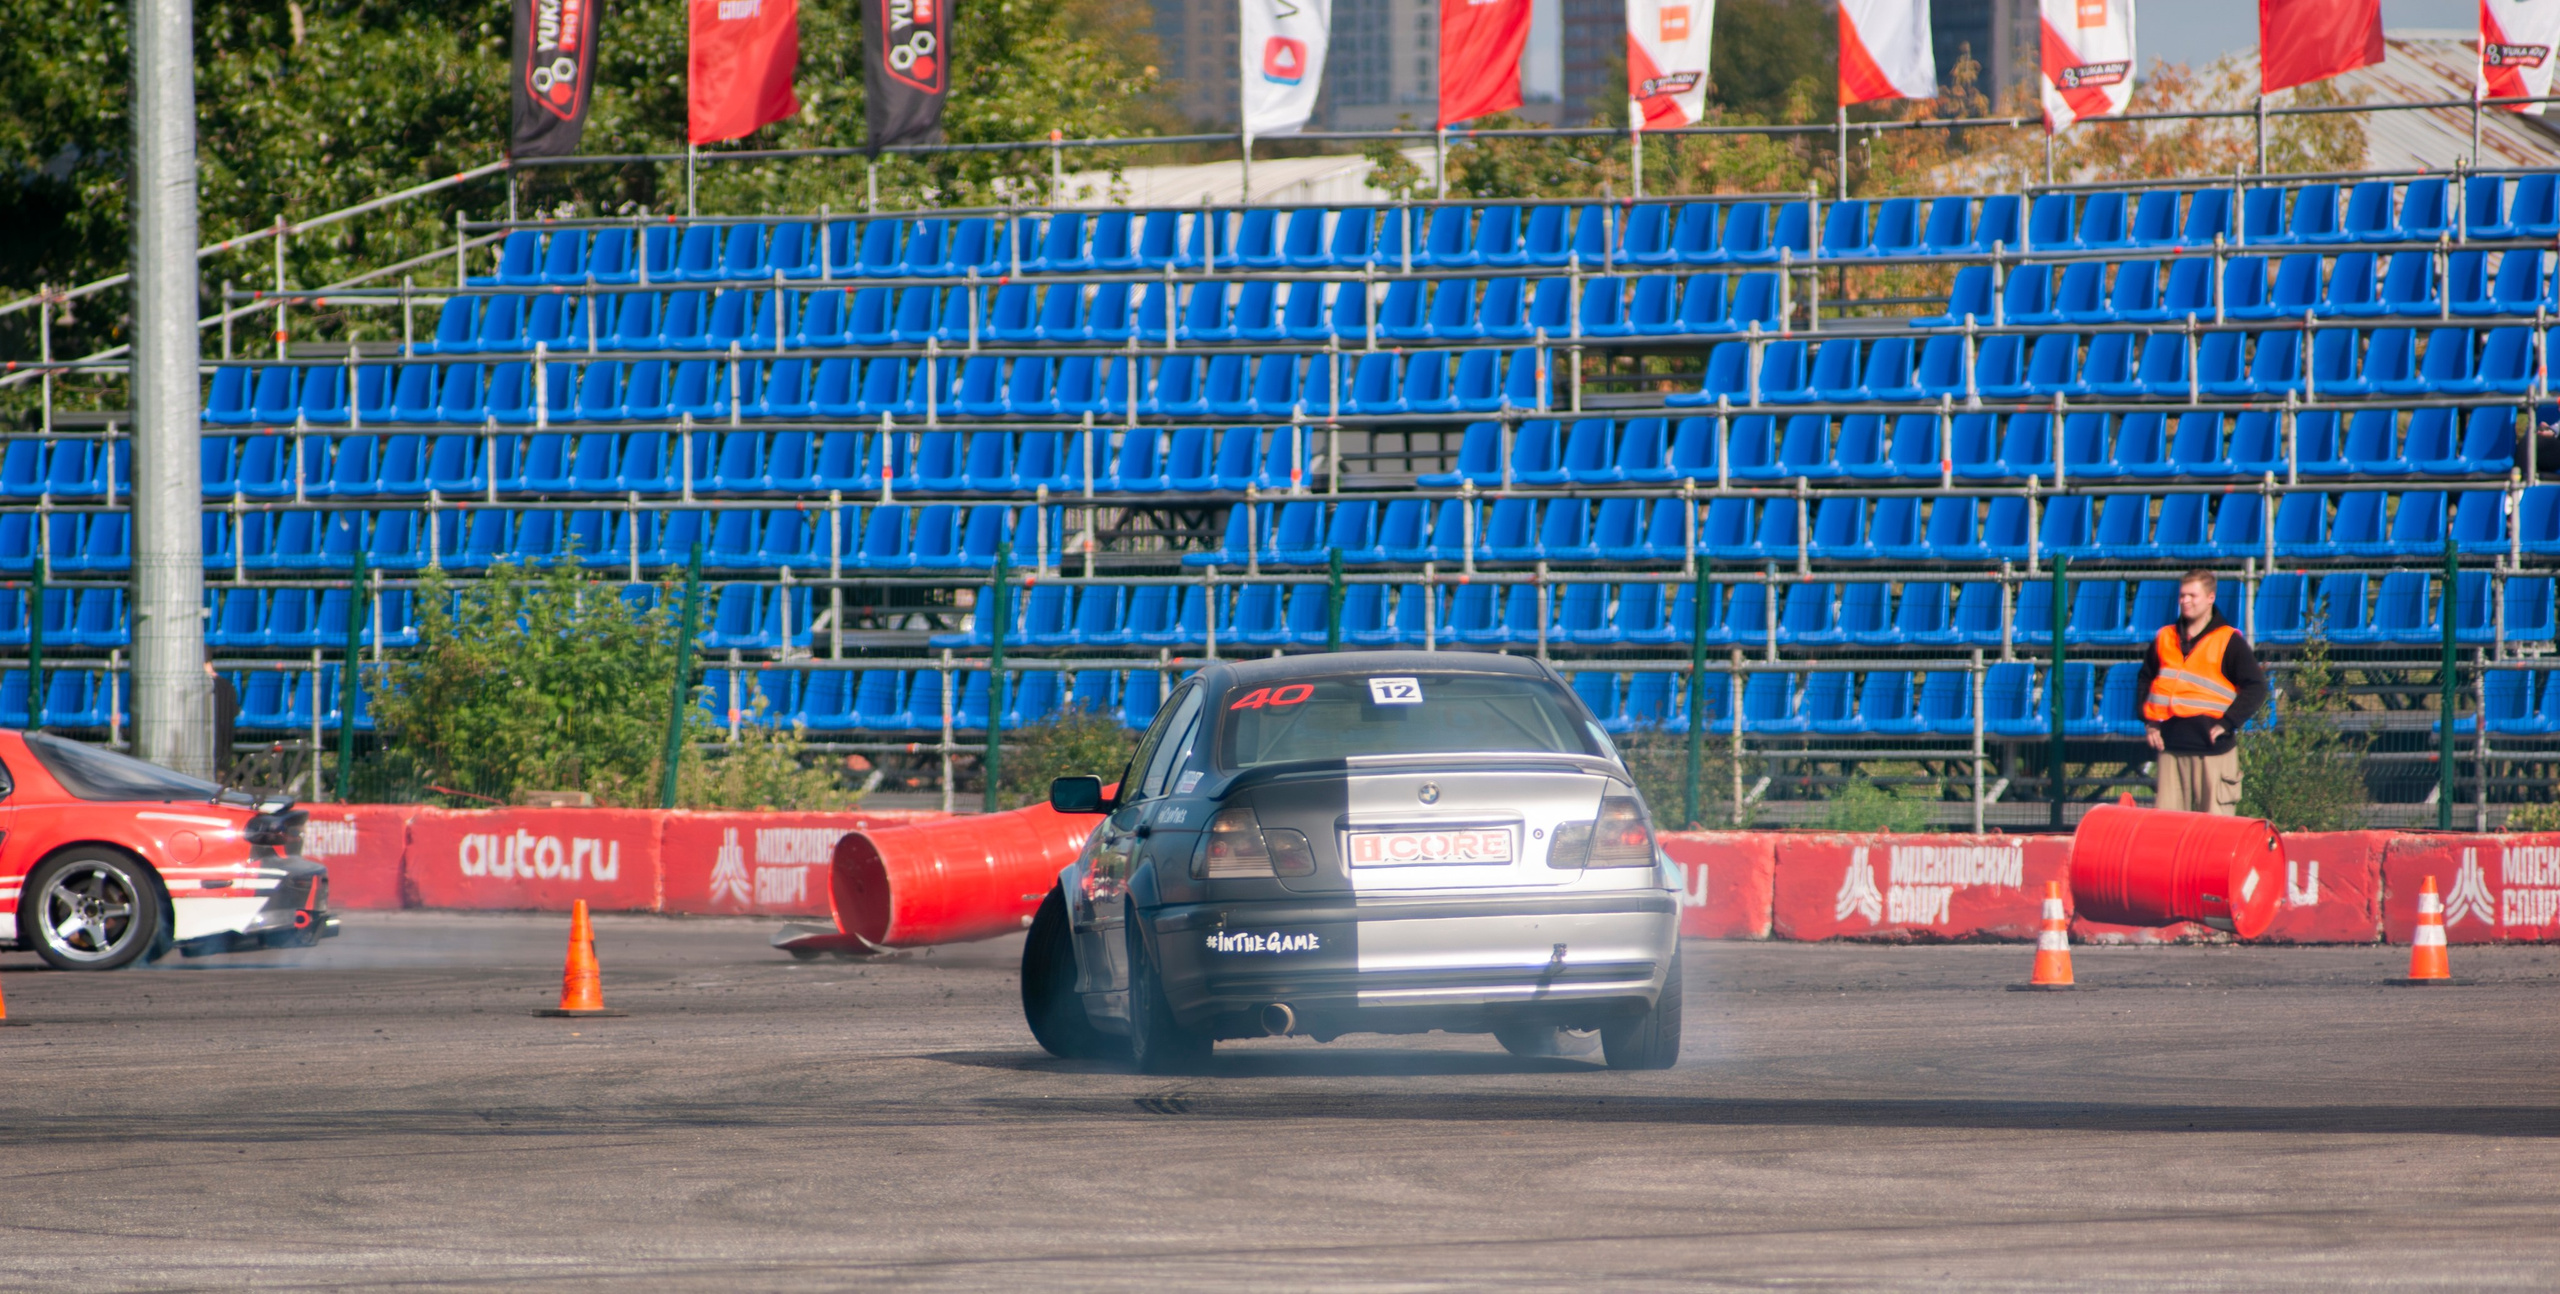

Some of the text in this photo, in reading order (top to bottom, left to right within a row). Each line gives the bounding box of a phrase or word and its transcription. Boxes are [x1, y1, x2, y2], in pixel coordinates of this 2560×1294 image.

[537, 0, 561, 53] YUK
[1230, 684, 1315, 711] 40
[1375, 684, 1417, 699] 12
[459, 828, 620, 882] auto.ru
[1388, 833, 1508, 859] CORE
[1889, 838, 2023, 888] МОСКОВСКИЙ
[754, 866, 809, 904] СПОРТ
[2501, 888, 2560, 926] СПОР
